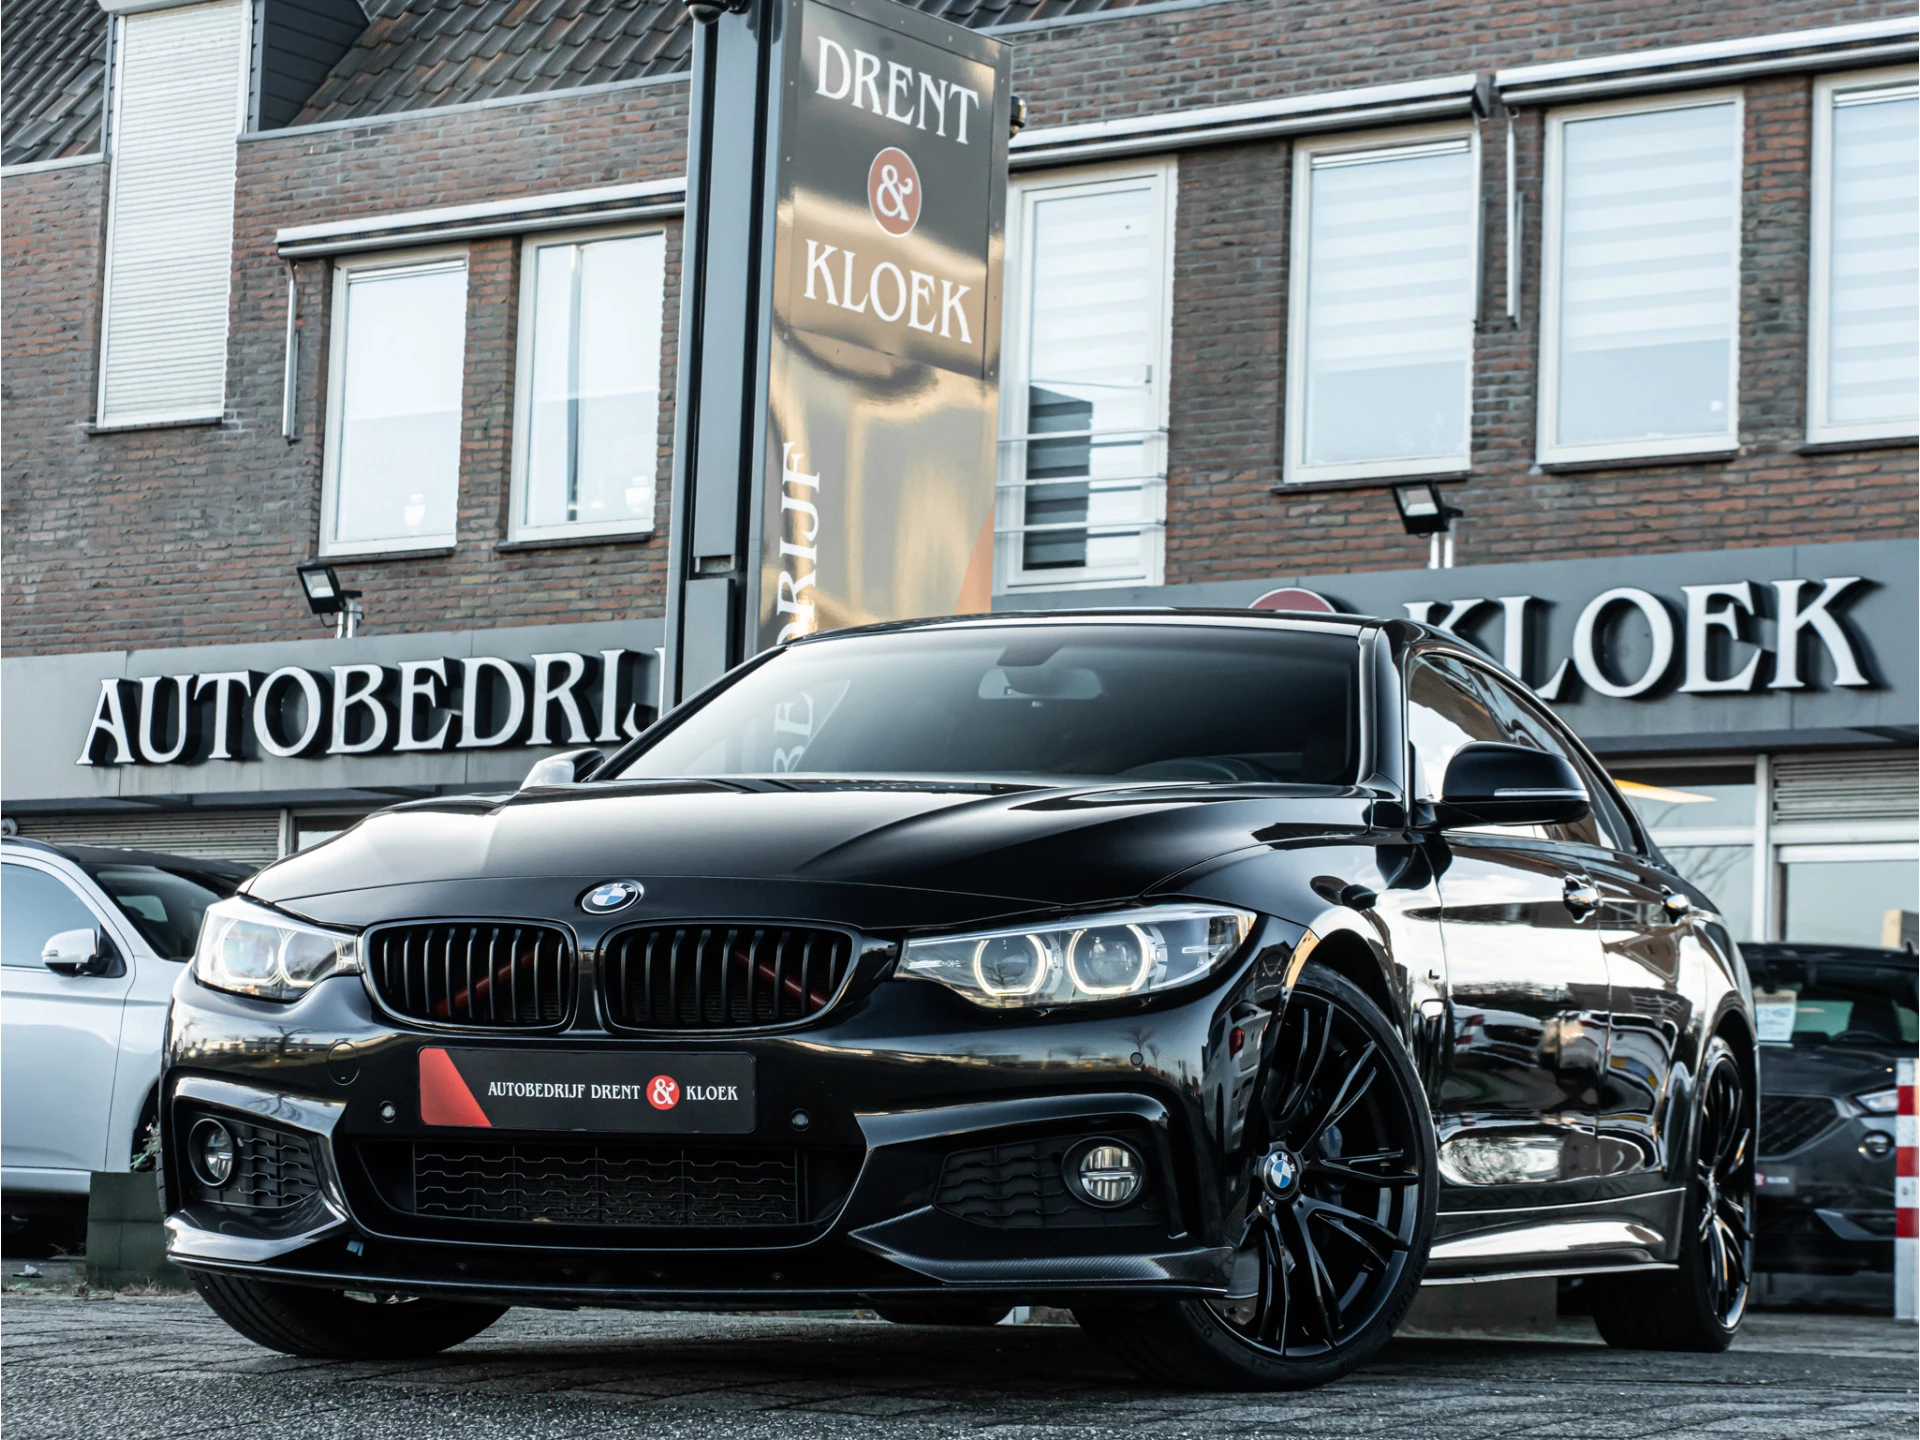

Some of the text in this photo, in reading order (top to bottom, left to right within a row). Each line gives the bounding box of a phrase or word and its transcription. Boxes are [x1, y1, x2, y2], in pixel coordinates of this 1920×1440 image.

[816, 36, 979, 144] DRENT
[876, 164, 913, 222] &
[803, 239, 973, 344] KLOEK
[488, 1078, 739, 1105] AUTOBEDRIJF DRENT & KLOEK
